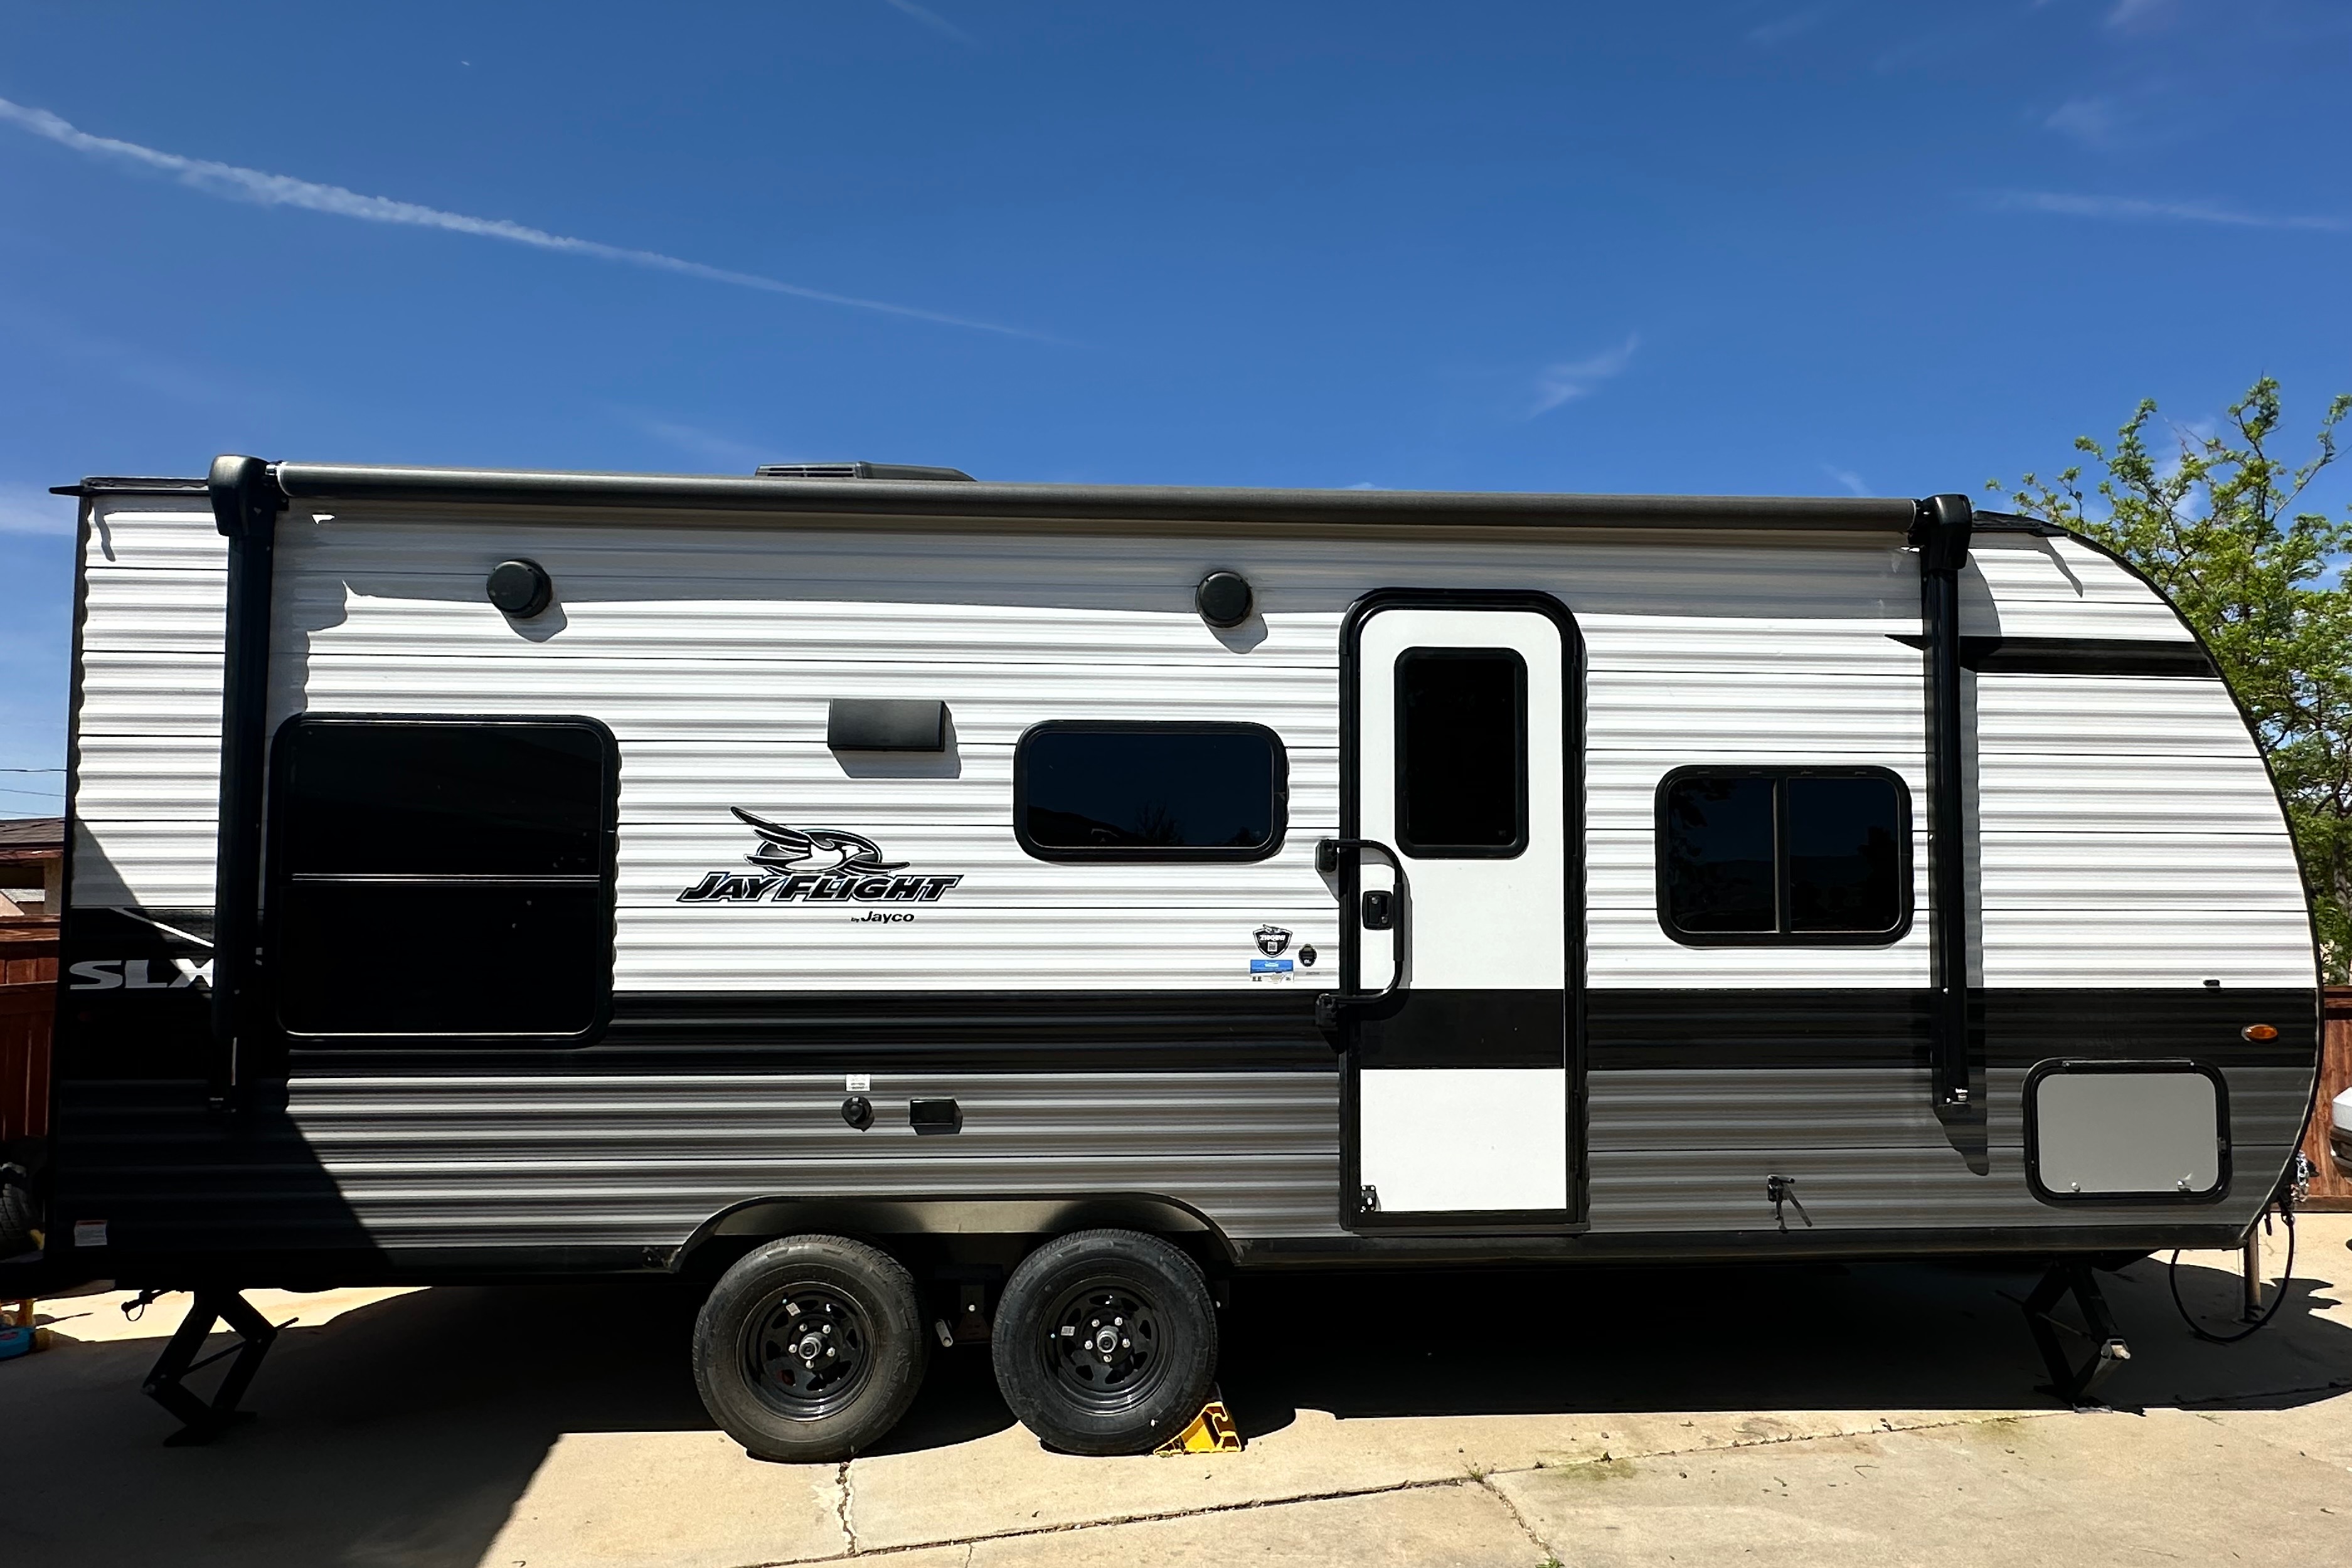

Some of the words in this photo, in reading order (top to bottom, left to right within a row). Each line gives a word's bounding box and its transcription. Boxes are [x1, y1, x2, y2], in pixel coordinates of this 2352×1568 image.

[676, 872, 779, 902] JAY
[771, 872, 964, 902] FLIGHT
[861, 911, 915, 924] Jayco
[69, 958, 214, 989] SLX
